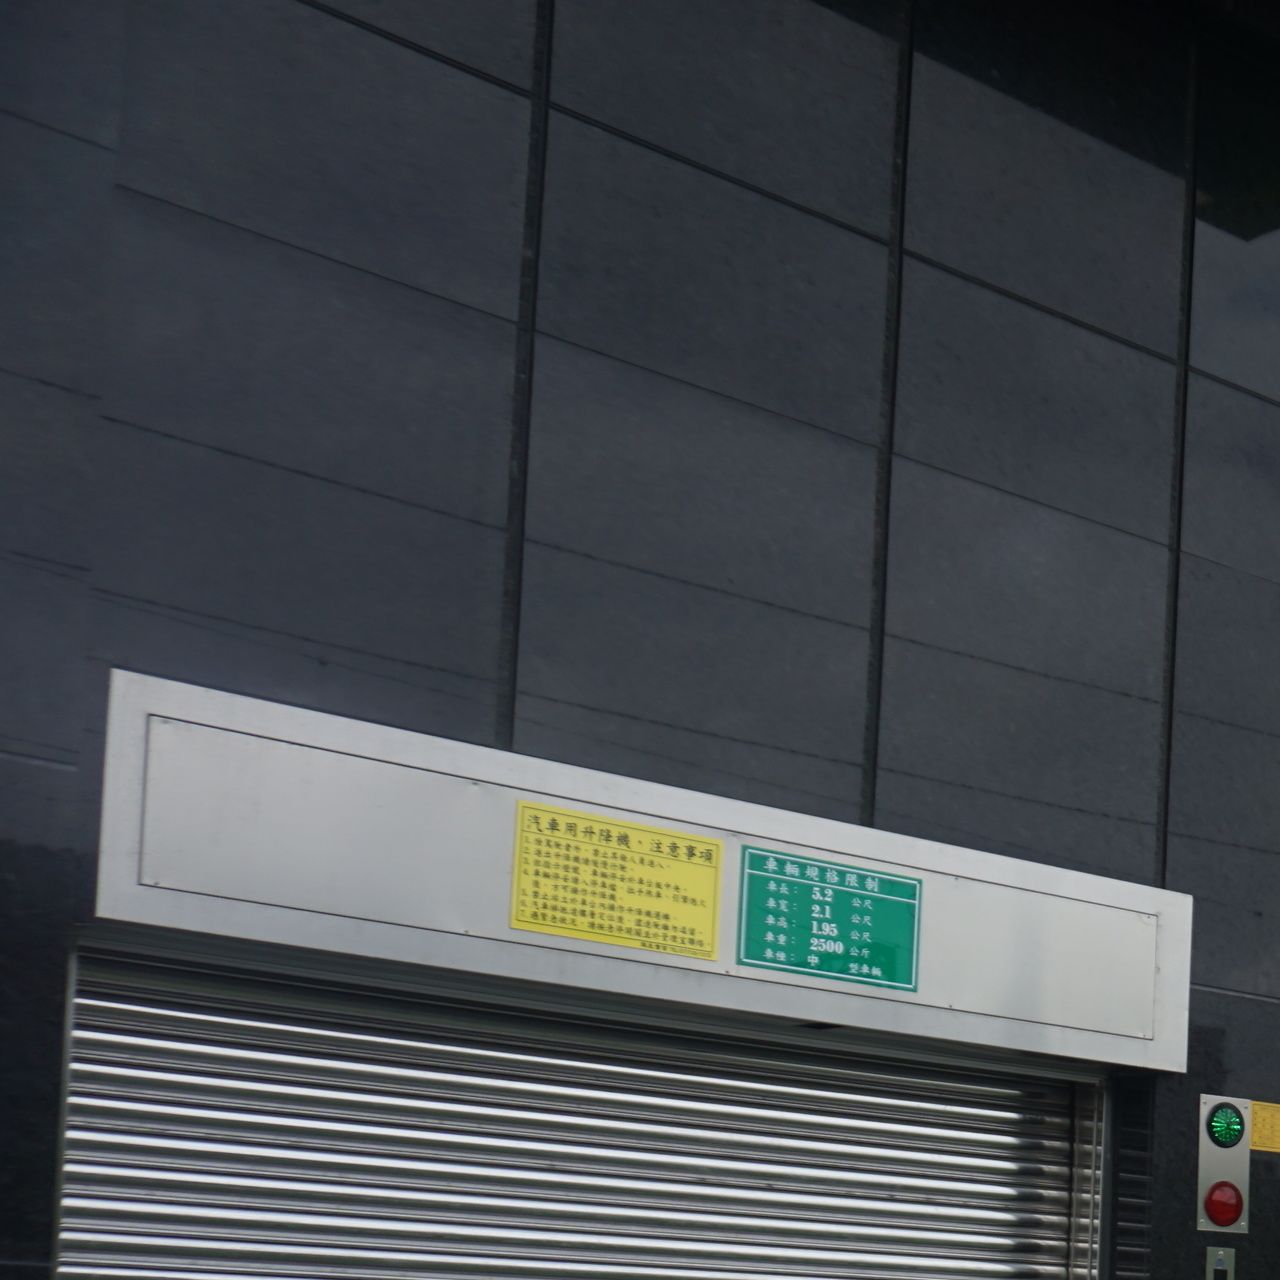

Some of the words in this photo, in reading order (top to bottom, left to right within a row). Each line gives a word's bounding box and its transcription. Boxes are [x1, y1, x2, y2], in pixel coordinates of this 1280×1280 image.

[763, 856, 879, 893] 車輛規格限制
[811, 887, 834, 902] 5.2
[850, 897, 873, 910] 公尺
[811, 905, 832, 919] 2.1
[850, 914, 872, 927] 公尺
[811, 921, 838, 936] 1.95
[849, 930, 872, 943] 公尺
[809, 937, 844, 954] 2500
[849, 947, 870, 959] 公斤
[807, 955, 820, 967] 中
